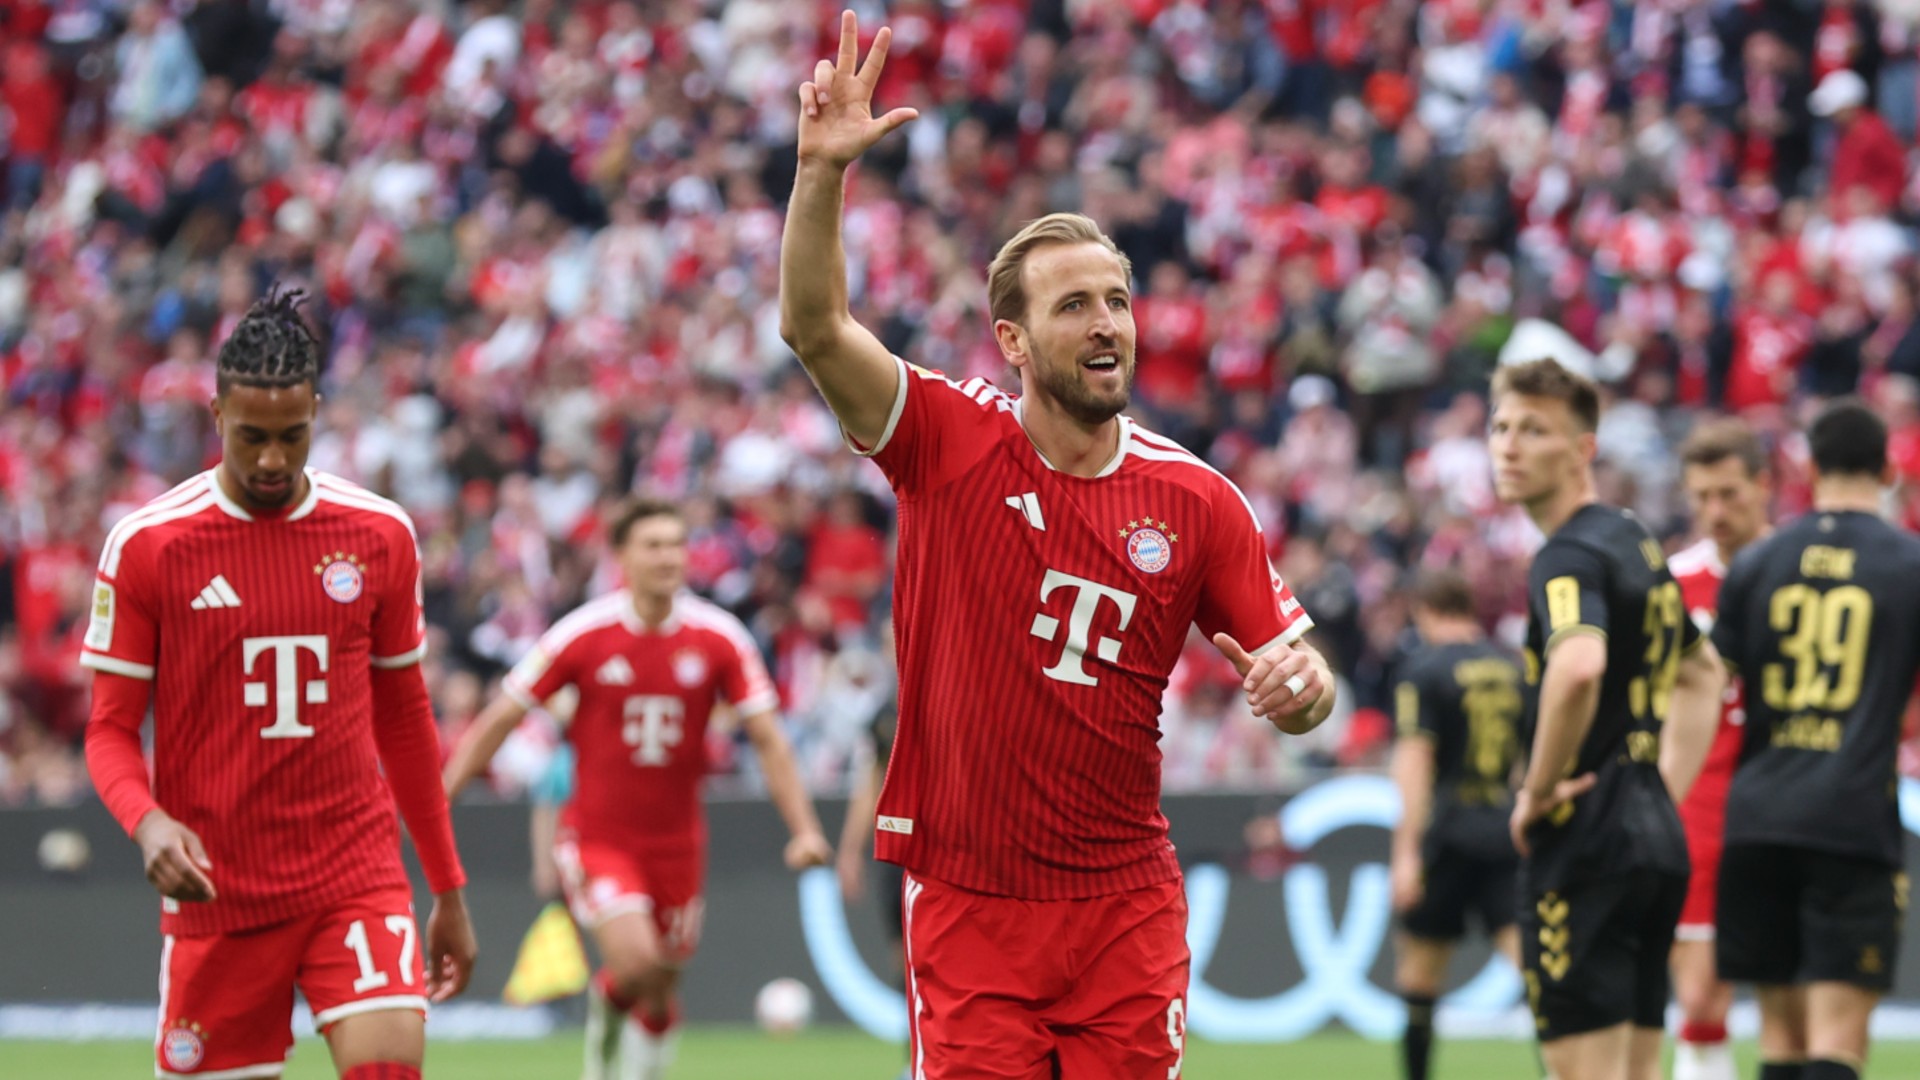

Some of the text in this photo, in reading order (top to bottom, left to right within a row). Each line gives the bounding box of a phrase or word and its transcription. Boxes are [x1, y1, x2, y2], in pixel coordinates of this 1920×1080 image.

[1030, 568, 1137, 687] T
[1761, 583, 1874, 712] 39
[243, 635, 328, 739] T
[343, 913, 416, 995] 17
[1166, 997, 1186, 1080] 9
